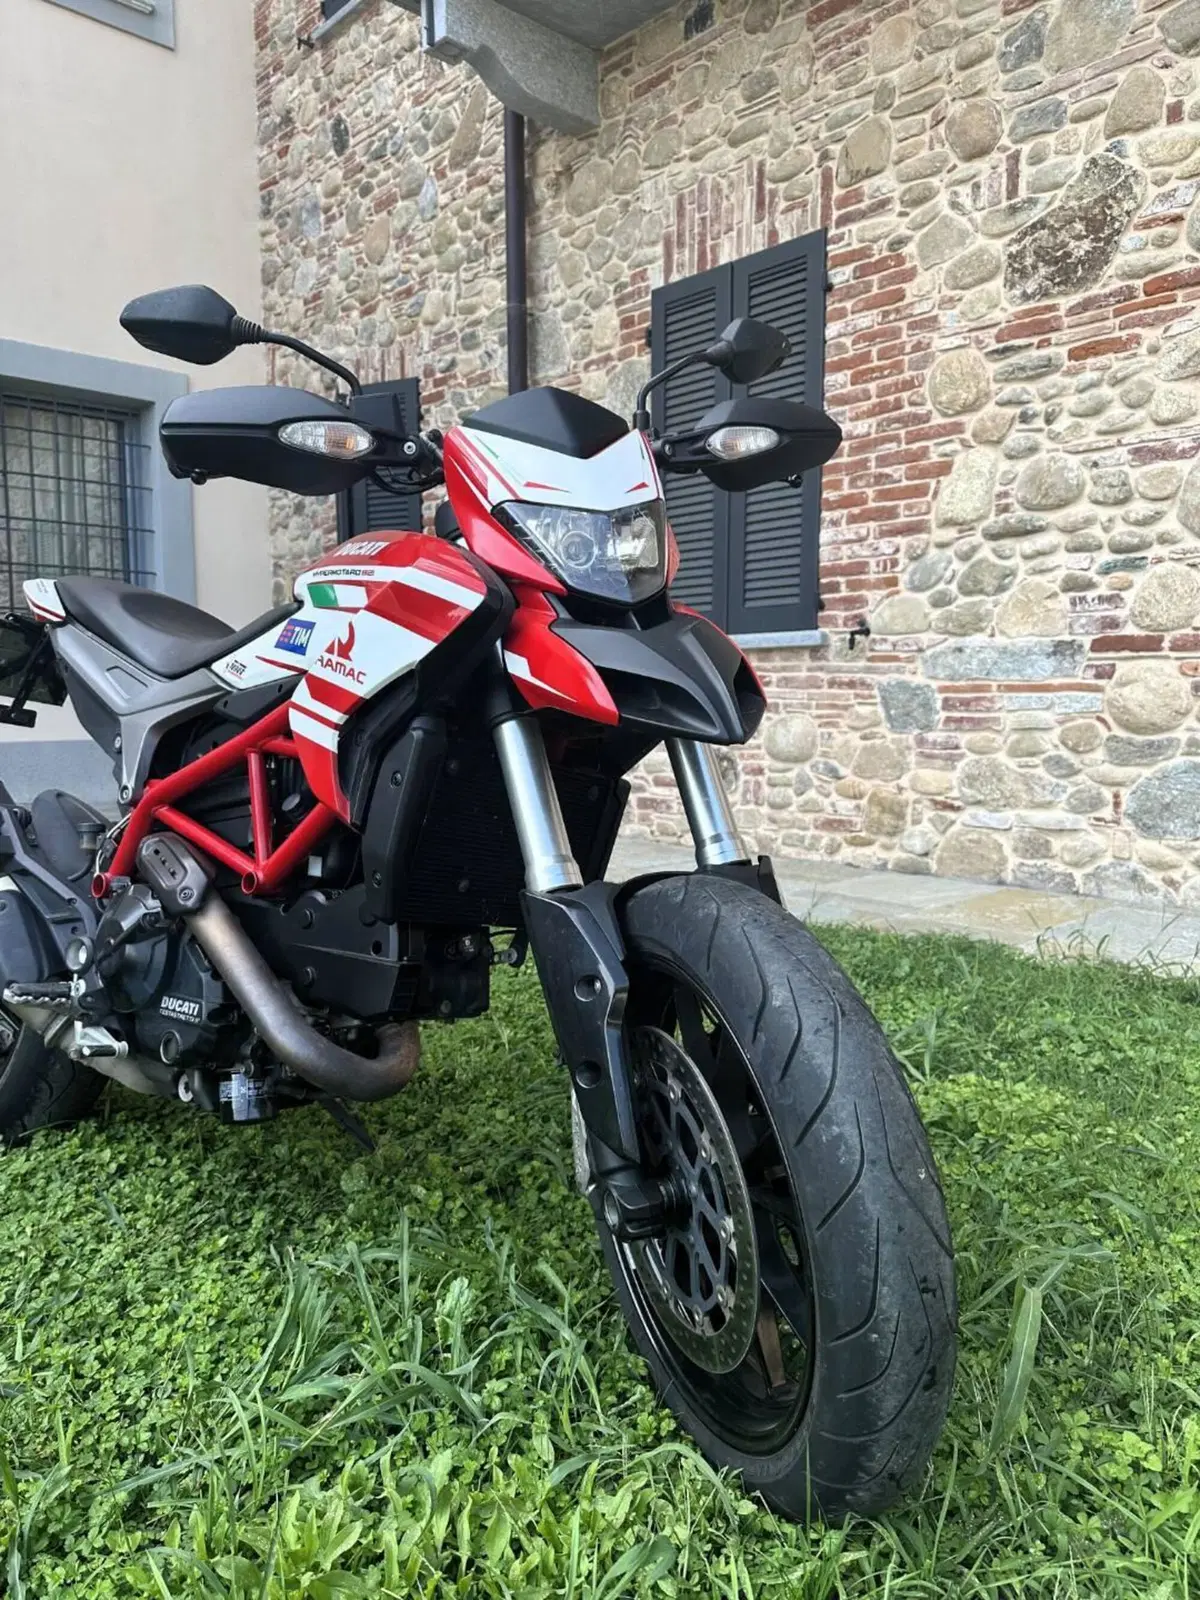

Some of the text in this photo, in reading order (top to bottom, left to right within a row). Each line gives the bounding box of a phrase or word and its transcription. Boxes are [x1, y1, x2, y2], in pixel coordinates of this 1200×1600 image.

[332, 541, 391, 557] DUCATI
[289, 626, 312, 647] TIM
[160, 995, 200, 1016] DUCATI
